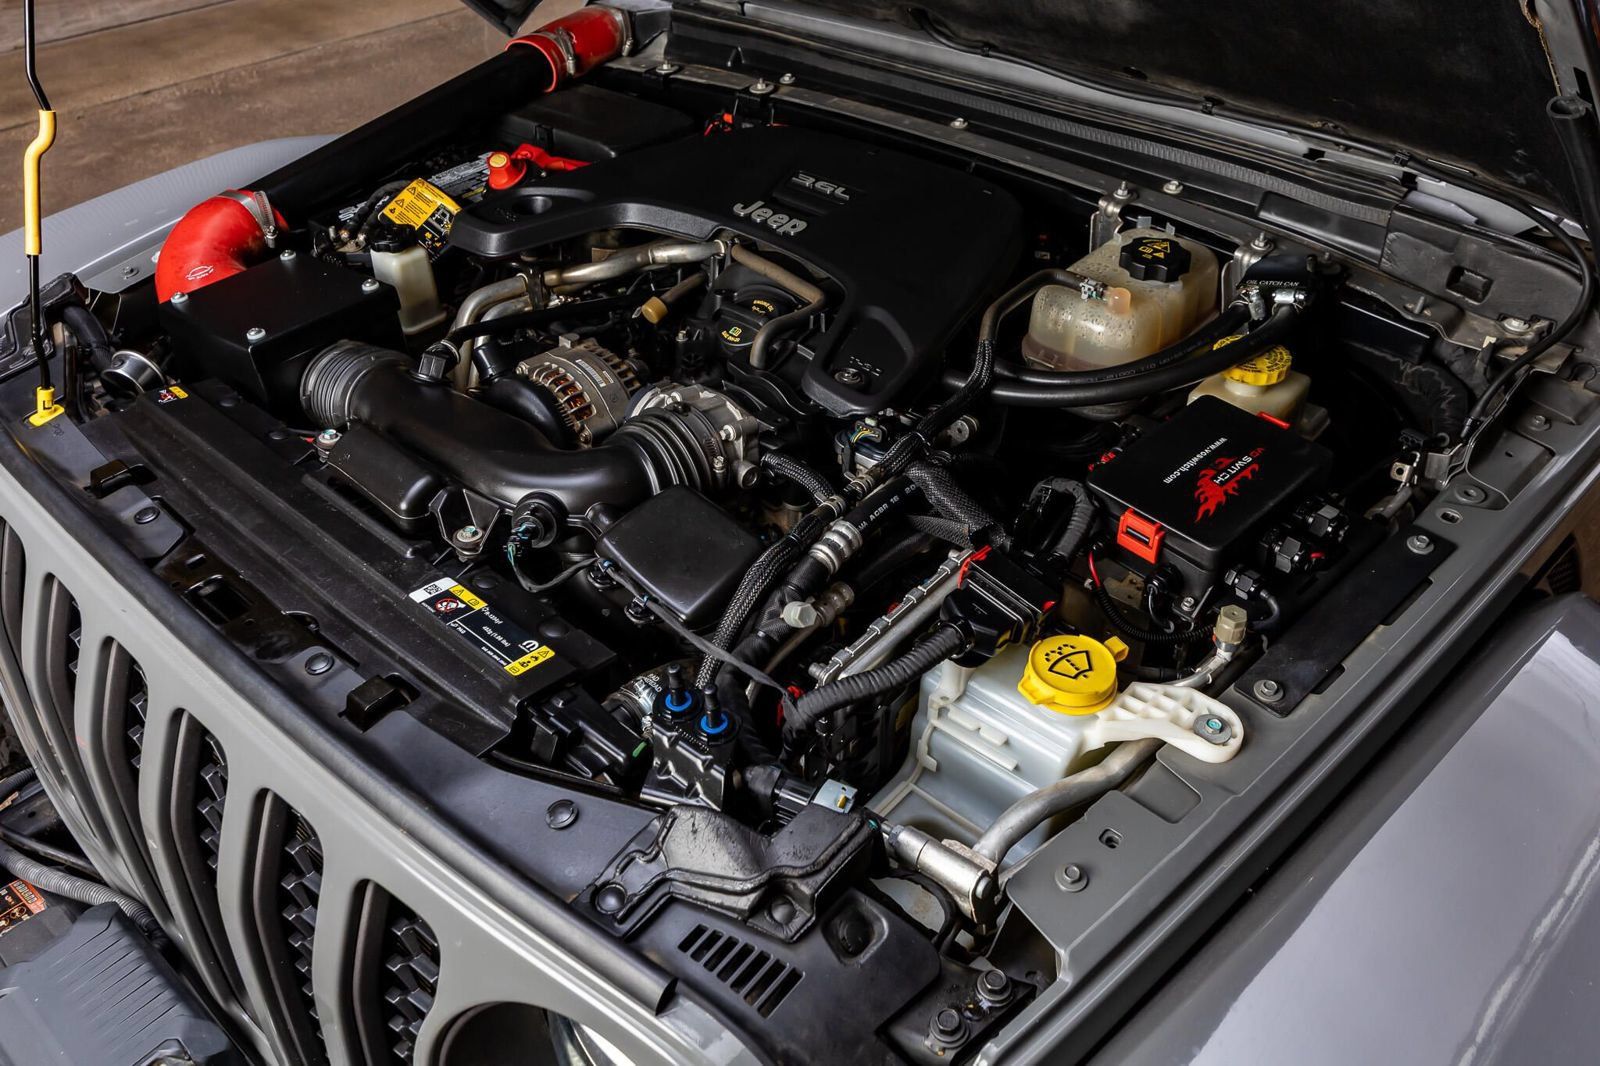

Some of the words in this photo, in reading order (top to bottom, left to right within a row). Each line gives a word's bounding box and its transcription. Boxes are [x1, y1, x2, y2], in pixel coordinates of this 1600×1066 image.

[791, 173, 850, 200] 3.6L
[732, 200, 808, 235] Jeep
[1162, 437, 1228, 484] www.voswitch.com
